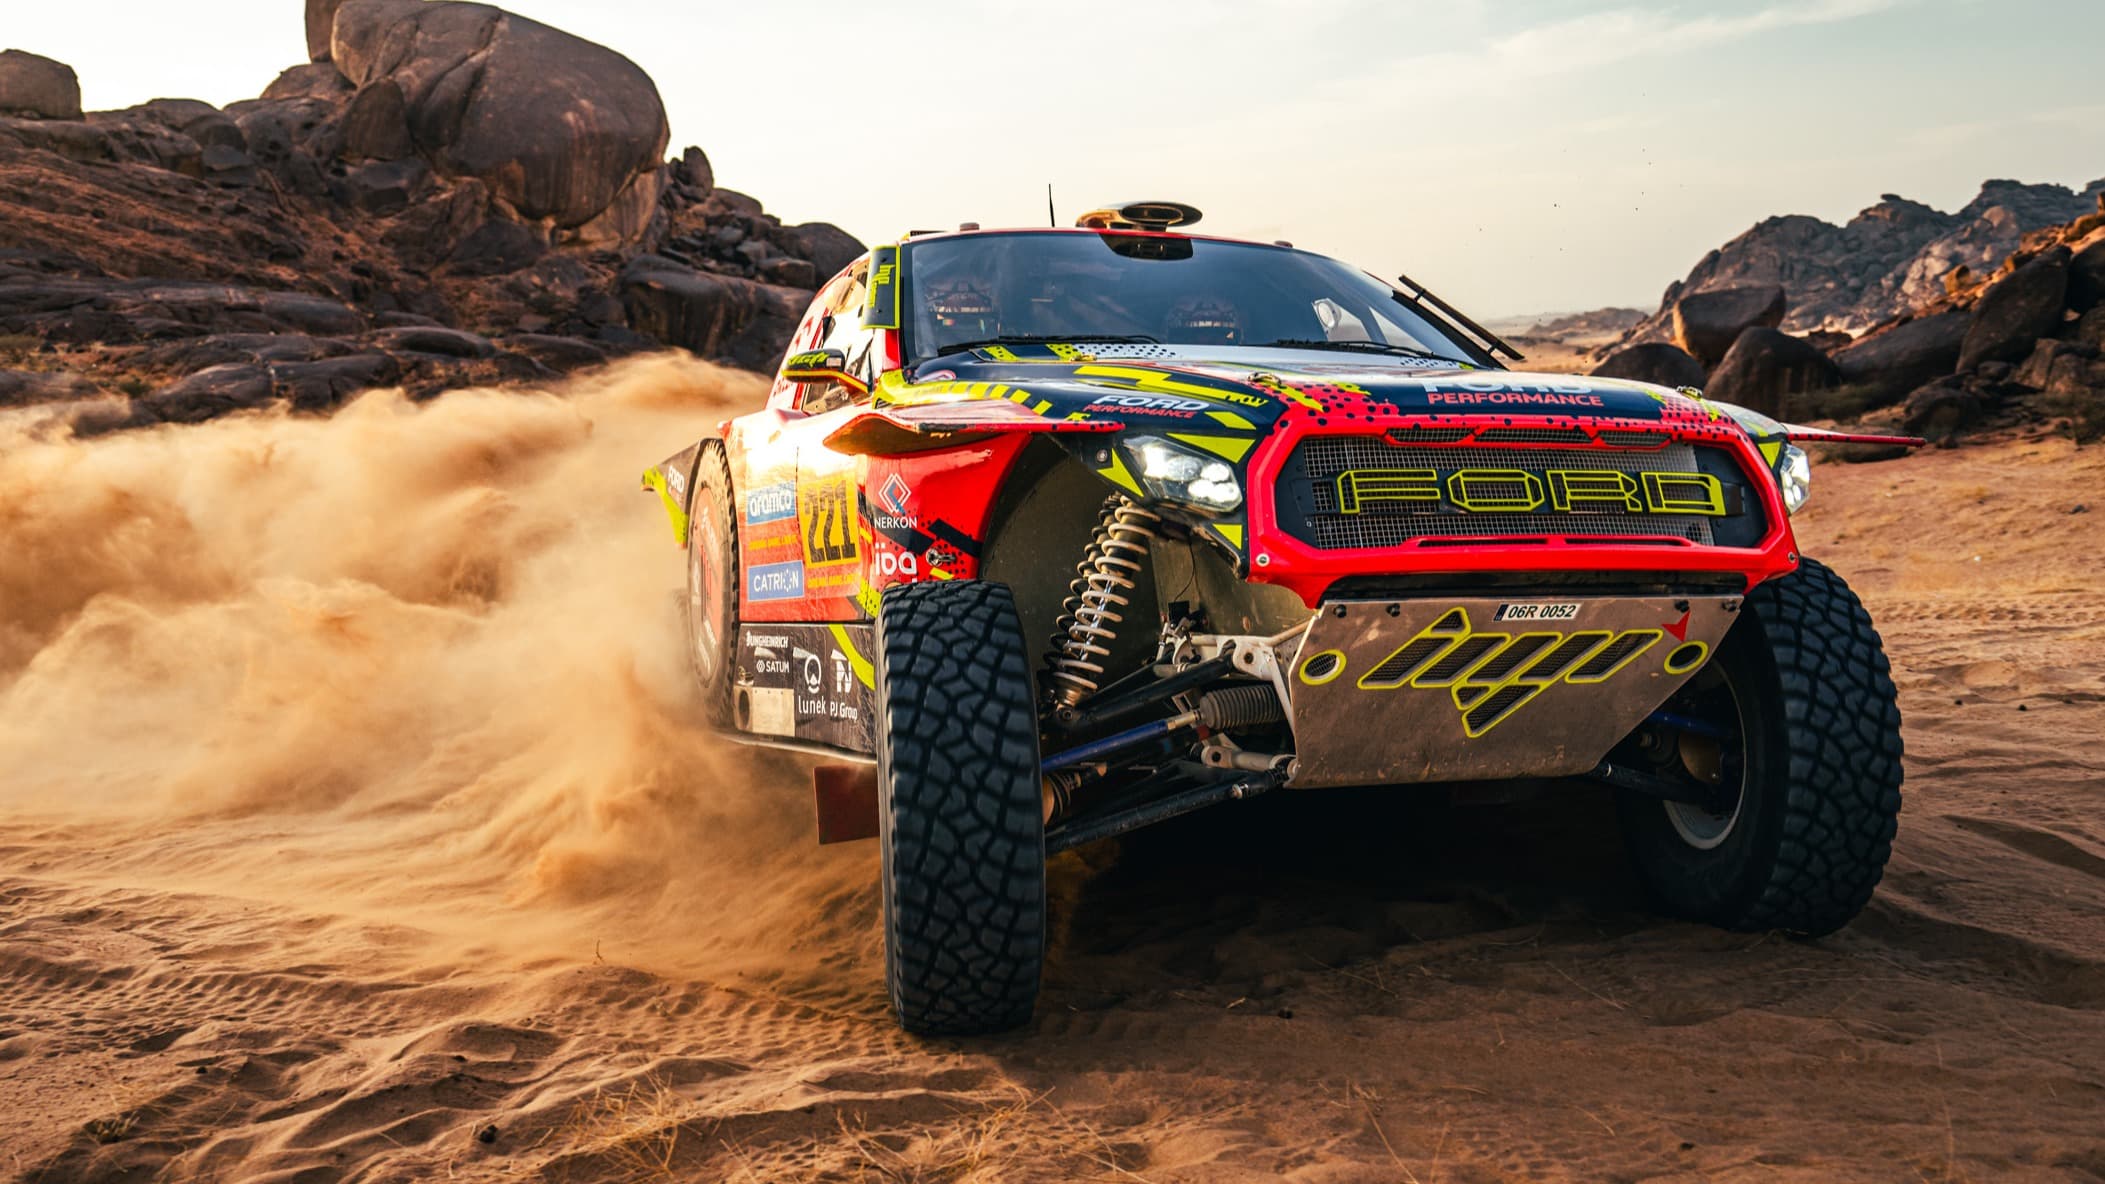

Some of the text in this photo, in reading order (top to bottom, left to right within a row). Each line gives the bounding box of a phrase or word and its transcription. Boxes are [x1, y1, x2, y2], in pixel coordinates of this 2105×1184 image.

[1093, 395, 1210, 411] FORD
[1427, 393, 1604, 407] PERFORMANCE
[1083, 404, 1199, 419] PERFORMANCE
[668, 465, 685, 494] FORD
[1337, 468, 1727, 517] FORD
[749, 488, 792, 517] aramco
[804, 480, 857, 563] 221
[874, 516, 918, 529] NERKON
[753, 568, 799, 593] CATRION
[1508, 604, 1577, 618] 06R 0052
[765, 660, 790, 673] SATUM
[830, 701, 858, 721] PJ Group
